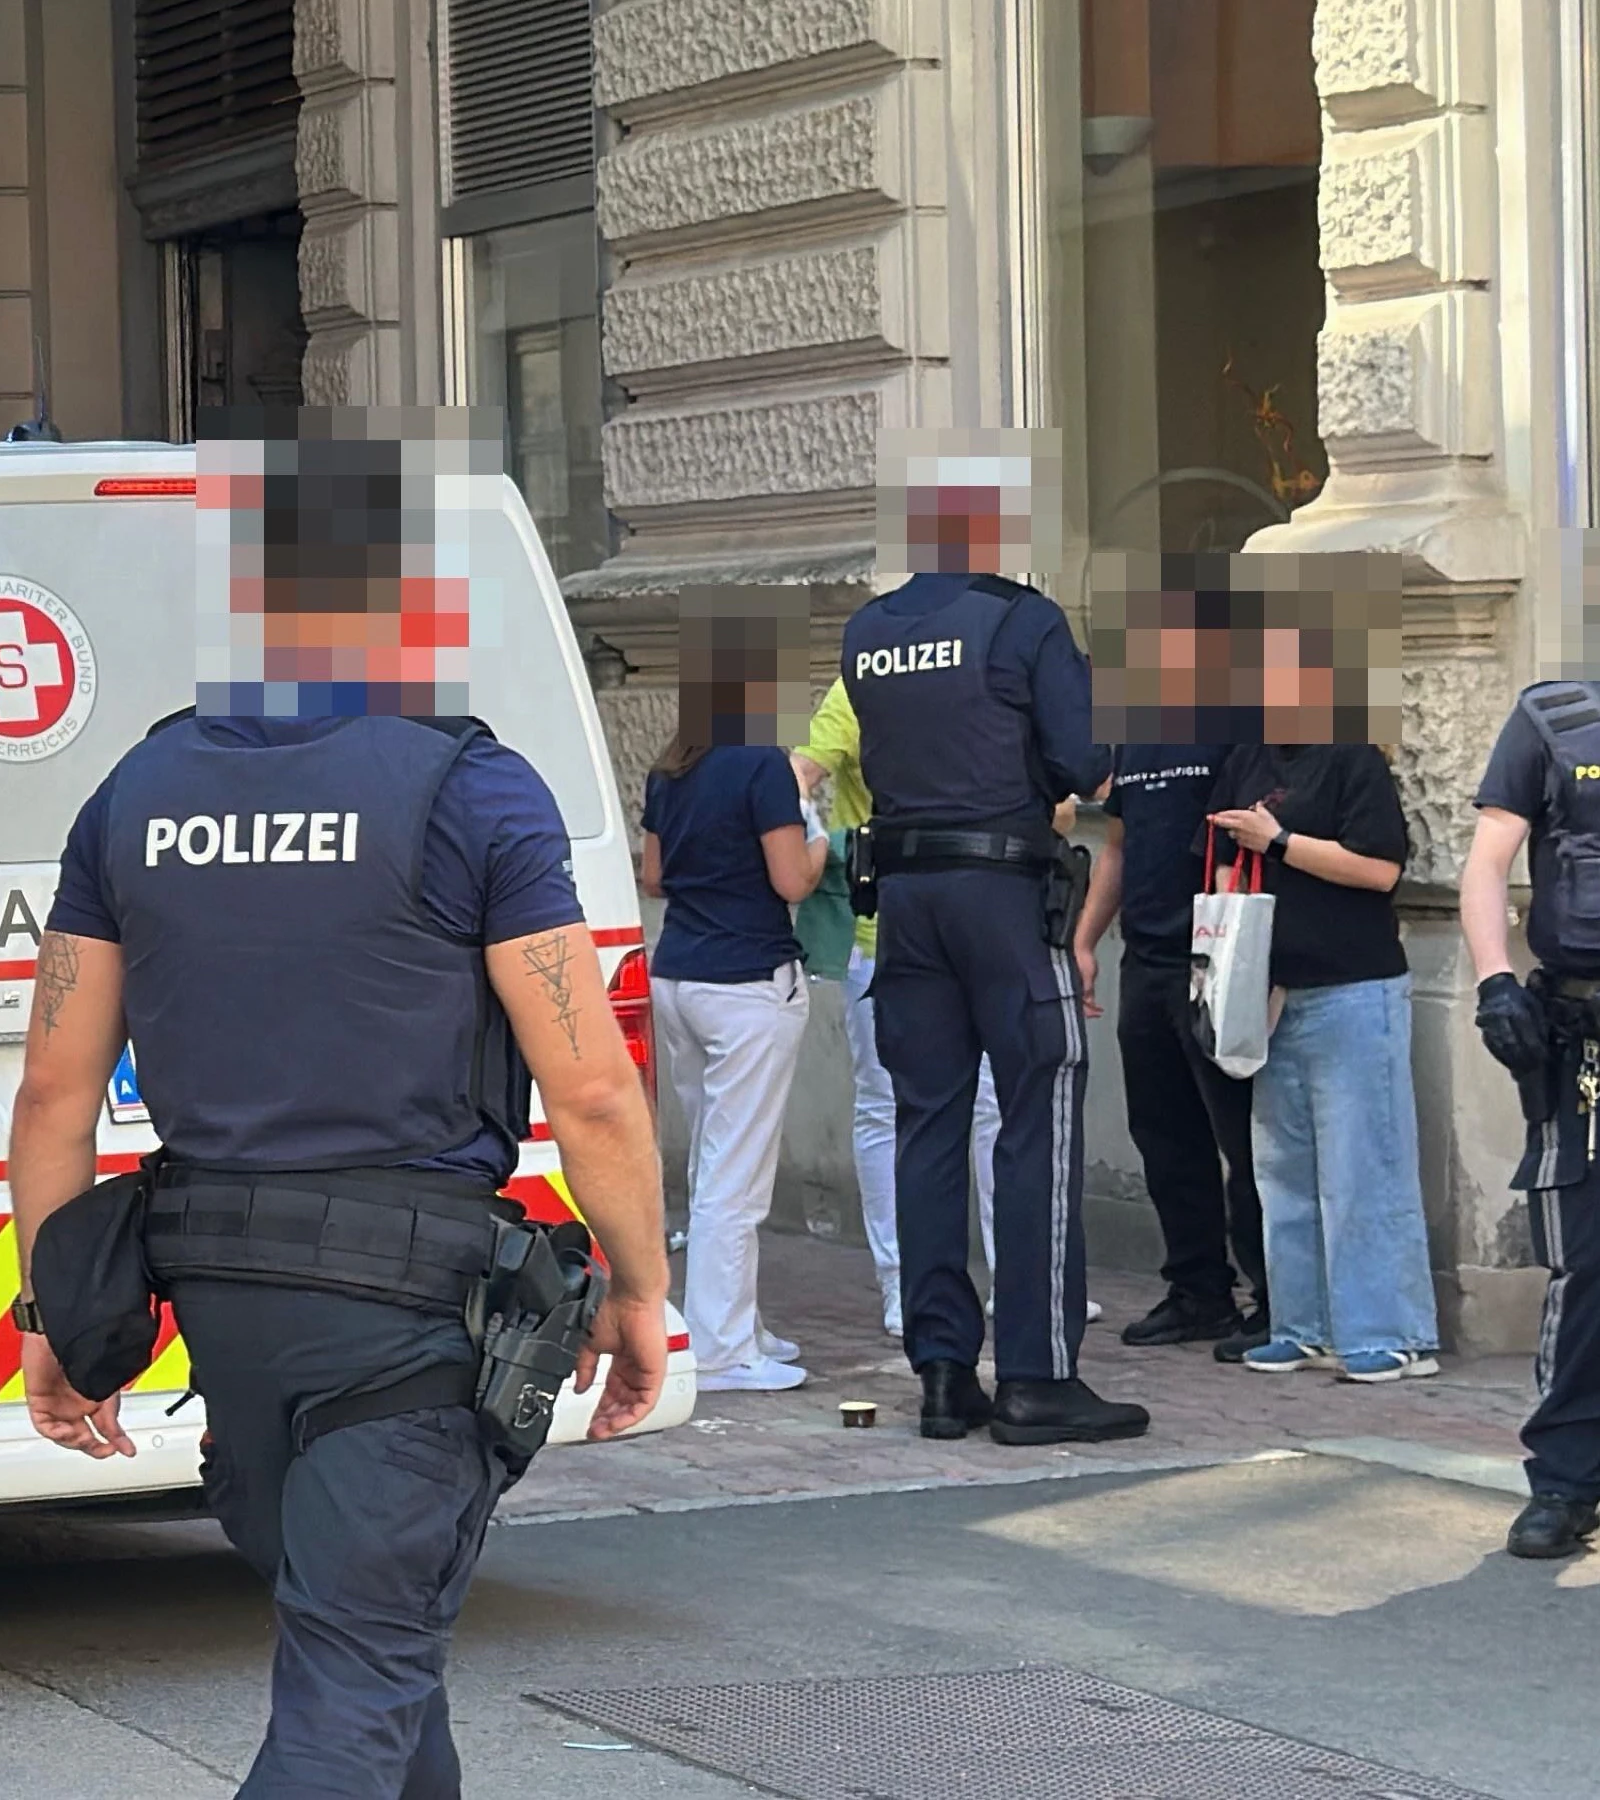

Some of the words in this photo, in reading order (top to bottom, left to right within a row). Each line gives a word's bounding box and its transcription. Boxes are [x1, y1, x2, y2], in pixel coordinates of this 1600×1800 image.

[71, 634, 93, 695] BUND
[856, 639, 962, 680] POLIZEI
[1114, 772, 1148, 787] OMMY
[145, 812, 359, 867] POLIZEI
[120, 1079, 134, 1097] A
